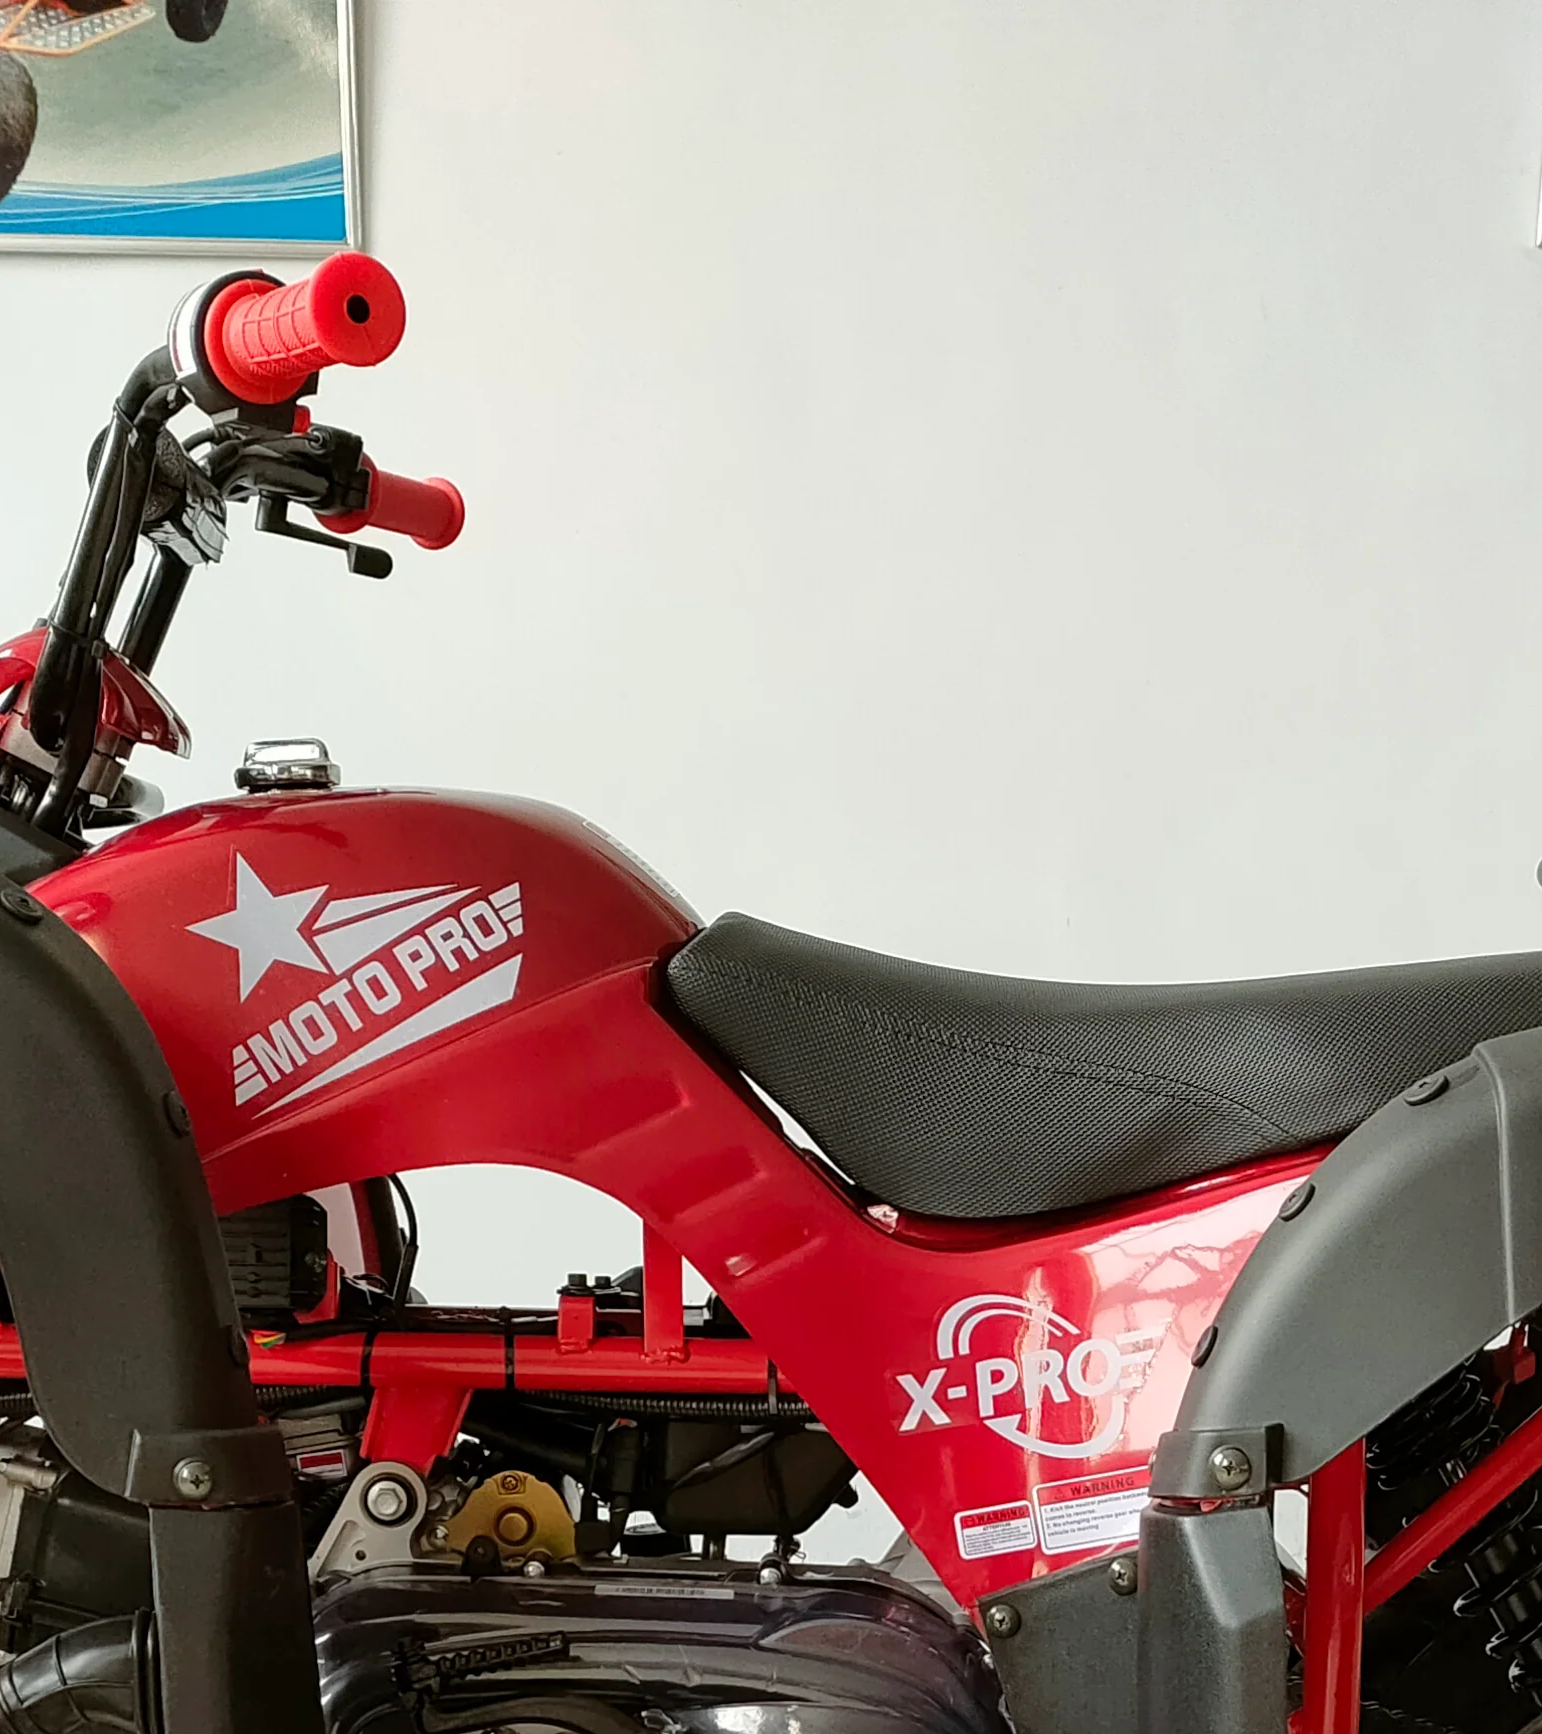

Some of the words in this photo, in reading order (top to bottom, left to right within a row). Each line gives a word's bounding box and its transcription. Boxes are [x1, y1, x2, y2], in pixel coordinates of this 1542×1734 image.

[246, 959, 402, 1085] MOTO
[392, 896, 509, 992] PRO
[895, 1337, 1123, 1433] X-PRO
[1070, 1476, 1134, 1497] WARNING
[1075, 1500, 1096, 1509] neutral
[1097, 1495, 1121, 1506] position
[977, 1507, 1025, 1523] WARNING
[1077, 1523, 1099, 1532] moving
